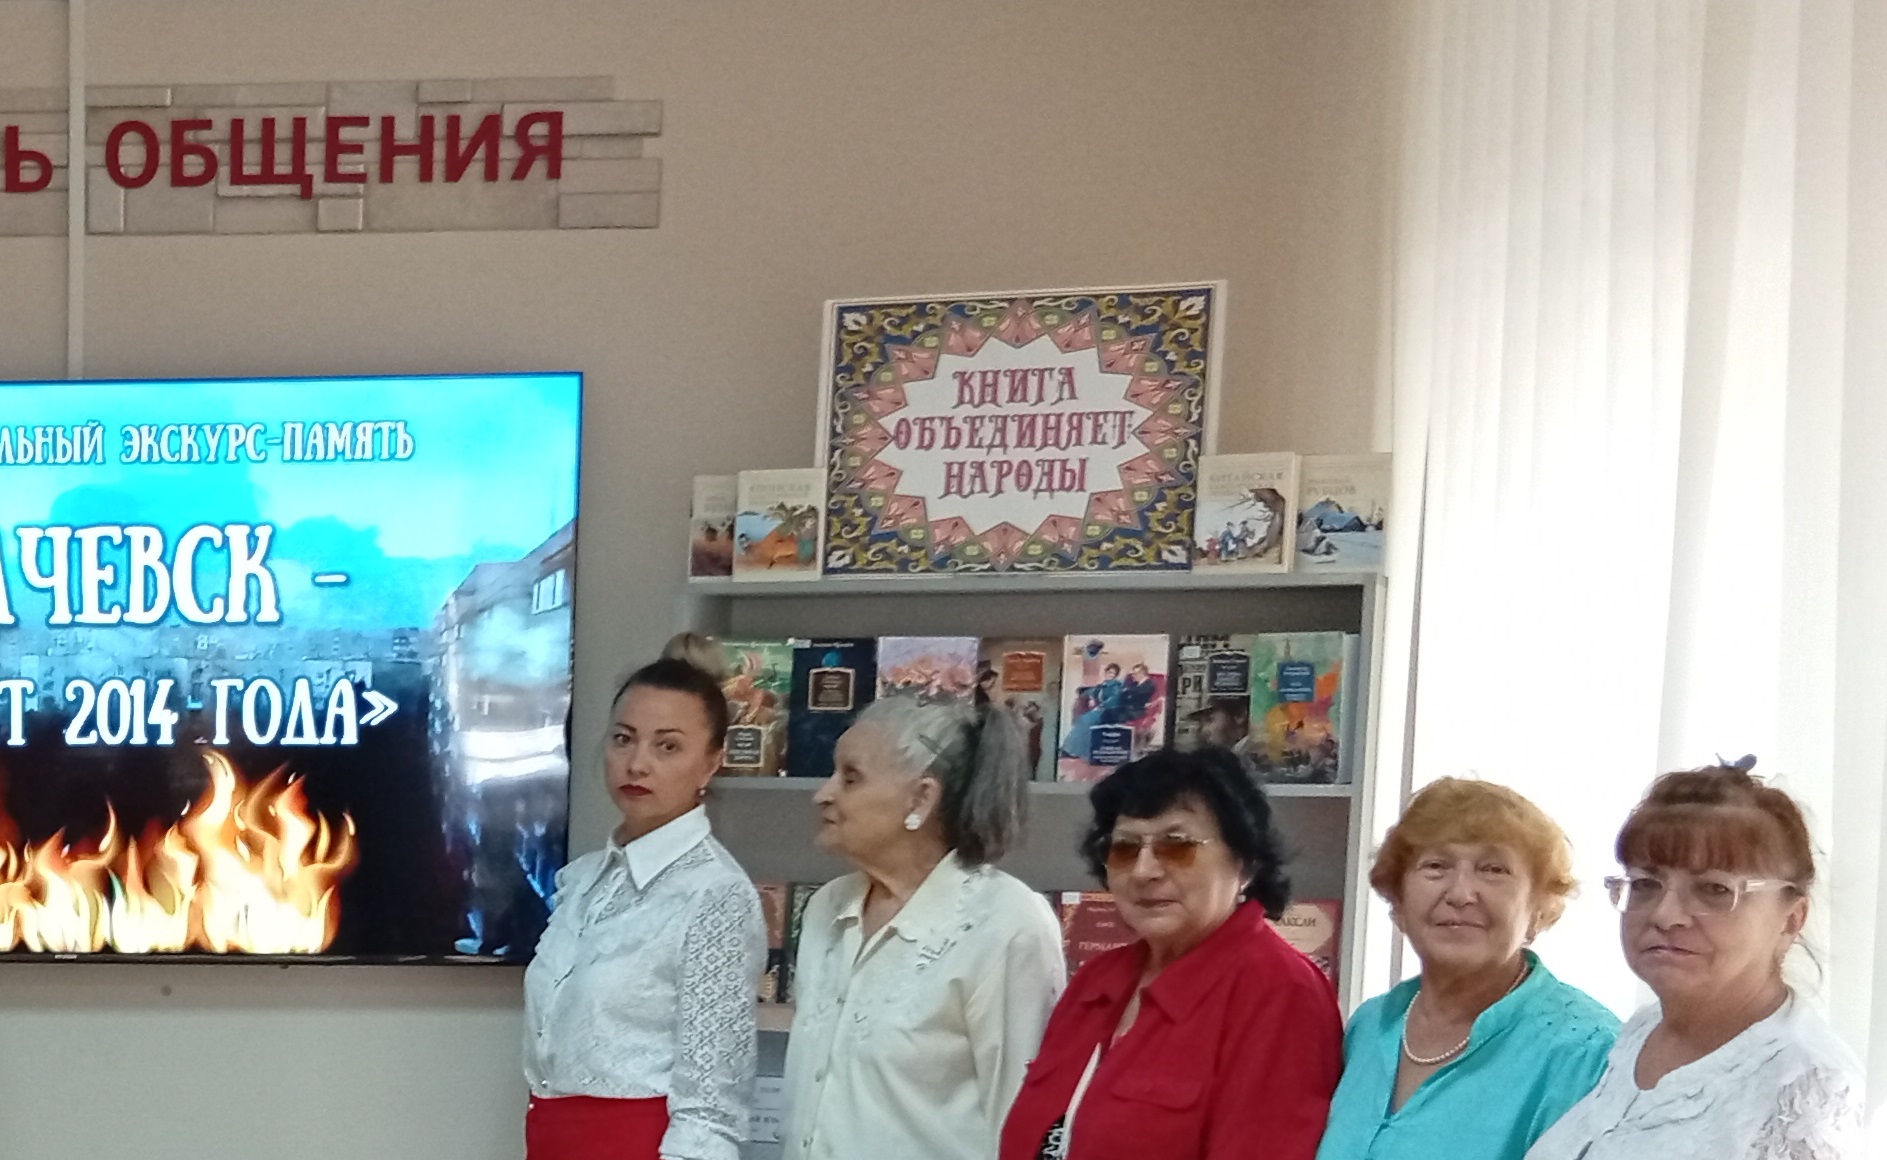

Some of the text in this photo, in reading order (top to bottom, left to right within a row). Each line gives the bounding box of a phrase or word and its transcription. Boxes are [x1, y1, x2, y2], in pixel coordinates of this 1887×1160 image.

[104, 111, 565, 200] ОБЩЕНИЯ
[952, 367, 1078, 409] КНИГА
[120, 419, 415, 463] ЭКСКУРС-ПАМЯТЬ
[892, 411, 1134, 454] ОБЪЕДИНЯЕТ
[939, 458, 1088, 499] НАРОДЫ
[65, 678, 178, 747] 2014
[213, 677, 400, 747] ГОДА»
